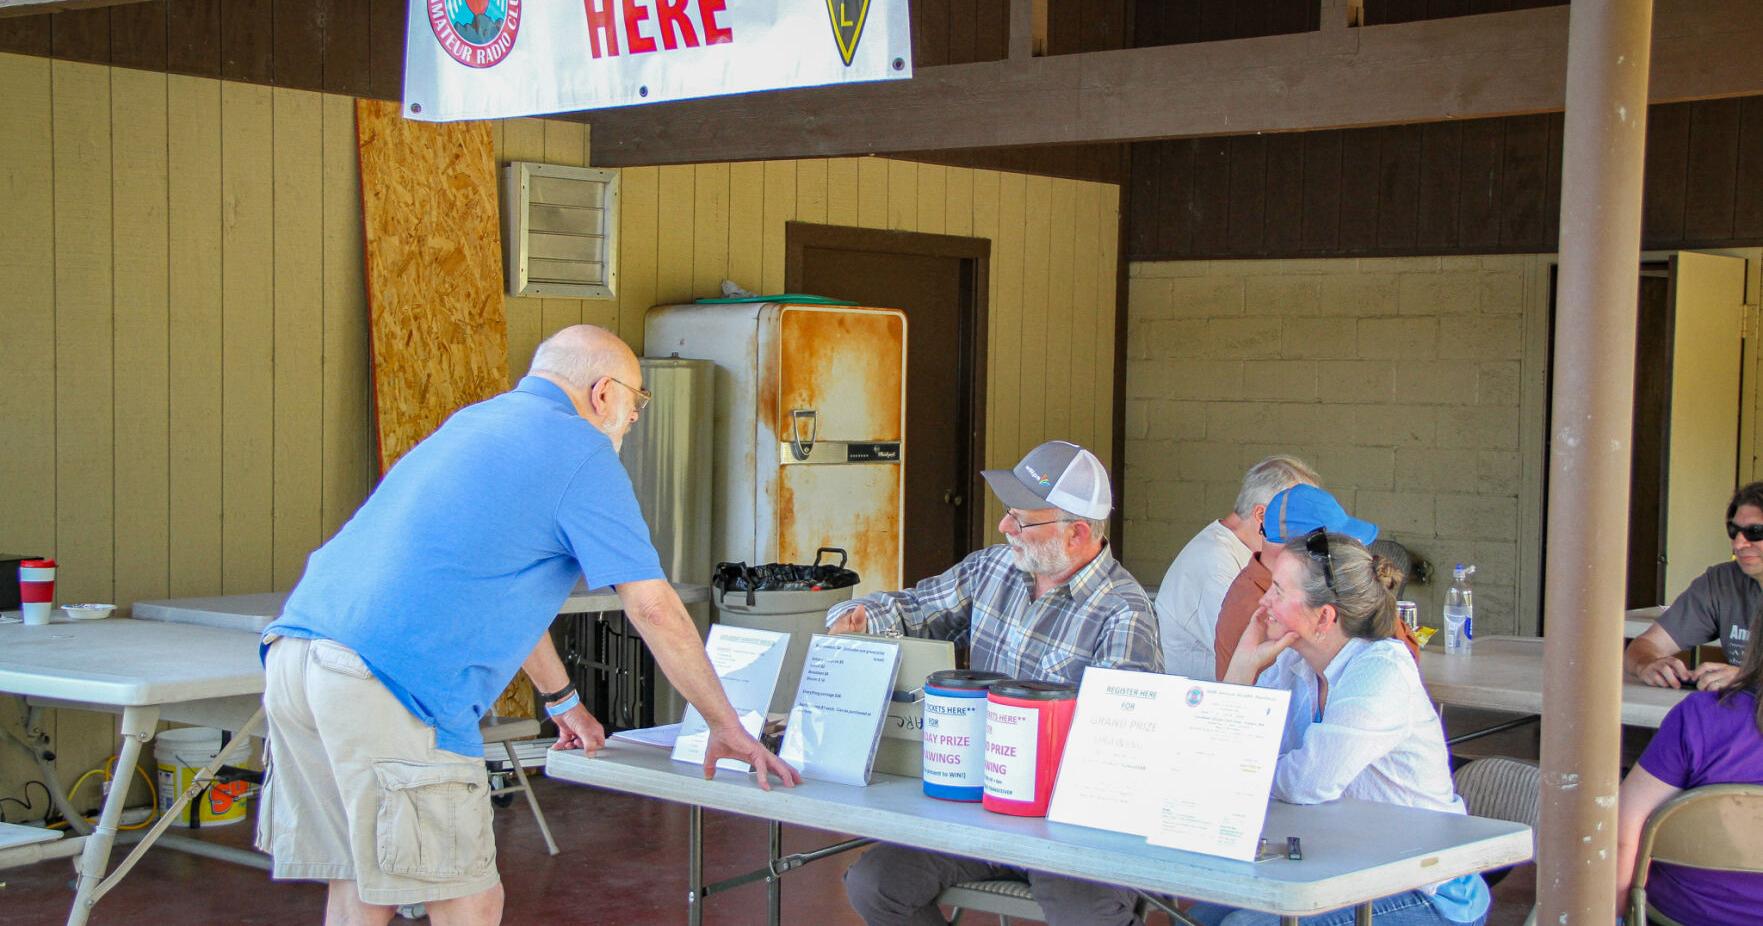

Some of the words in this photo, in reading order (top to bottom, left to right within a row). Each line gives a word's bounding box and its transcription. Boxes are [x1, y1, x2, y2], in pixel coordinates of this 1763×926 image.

[840, 3, 853, 26] L
[431, 0, 472, 62] MATEUR
[477, 32, 511, 64] RADIO
[584, 0, 733, 59] HERE
[1105, 686, 1138, 698] REGISTER
[1139, 689, 1157, 700] HERE
[1120, 701, 1136, 711] FOR
[928, 718, 939, 728] FOR
[1089, 716, 1127, 729] GRAND
[1129, 720, 1158, 733] PRIZE
[940, 735, 970, 747] PRIZE
[991, 743, 1017, 757] PRIZE
